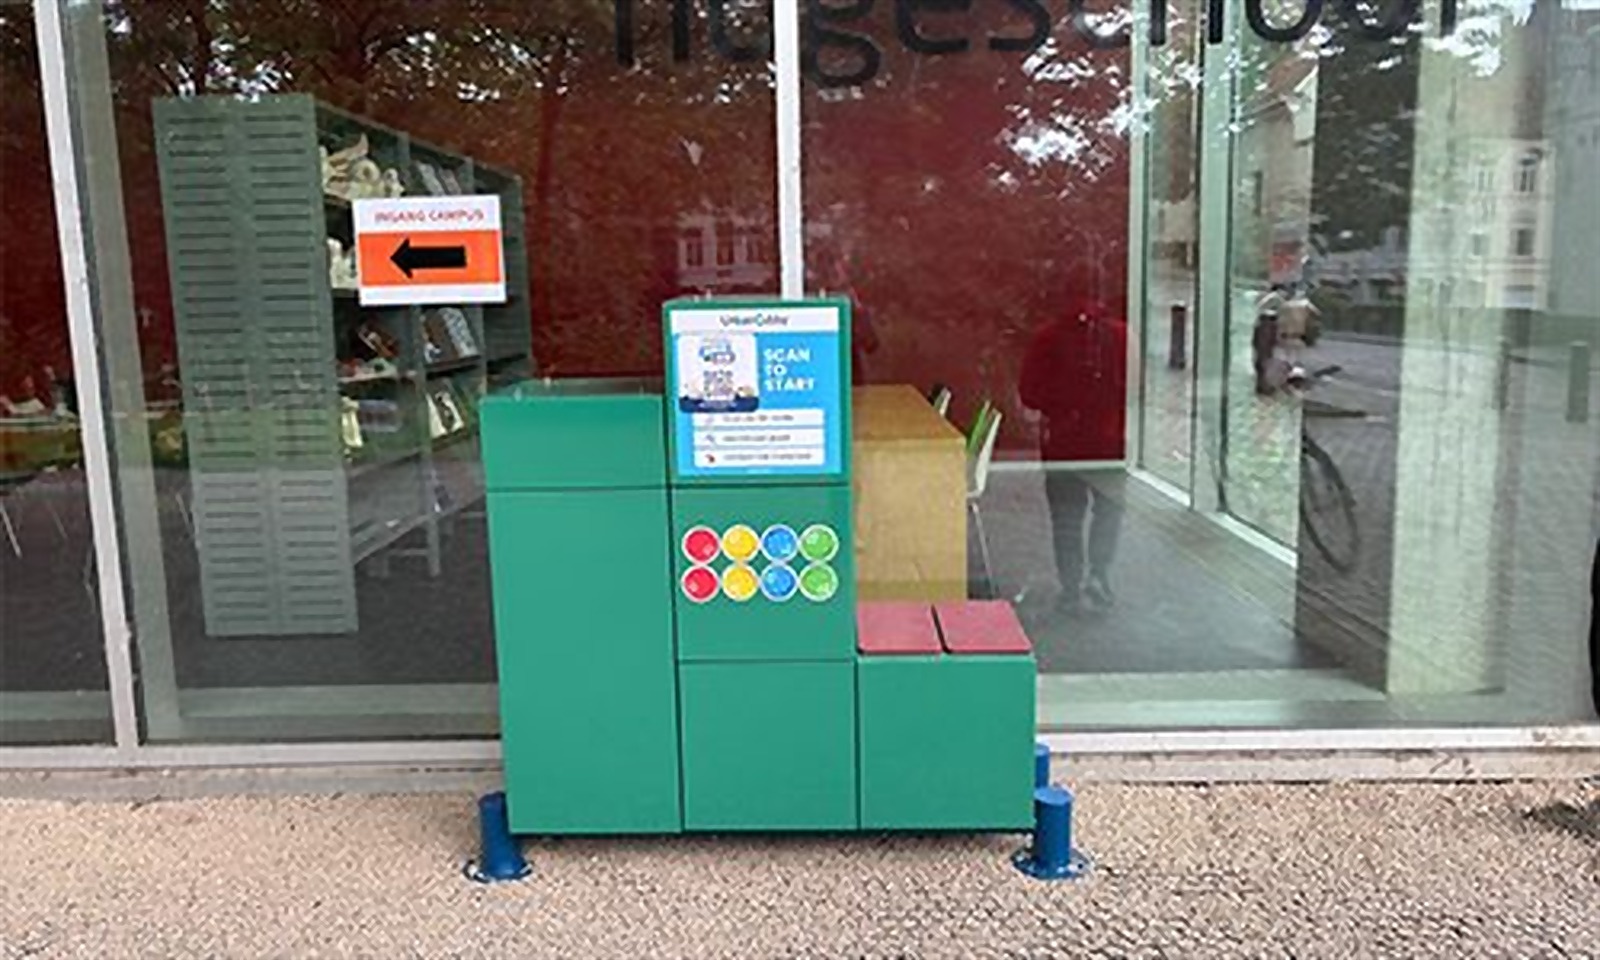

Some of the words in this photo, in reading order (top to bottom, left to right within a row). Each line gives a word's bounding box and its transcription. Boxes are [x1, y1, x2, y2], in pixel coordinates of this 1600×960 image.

[428, 208, 484, 222] CAMPUS
[763, 348, 810, 363] SCAN
[764, 363, 788, 377] TO
[763, 378, 815, 392] START
